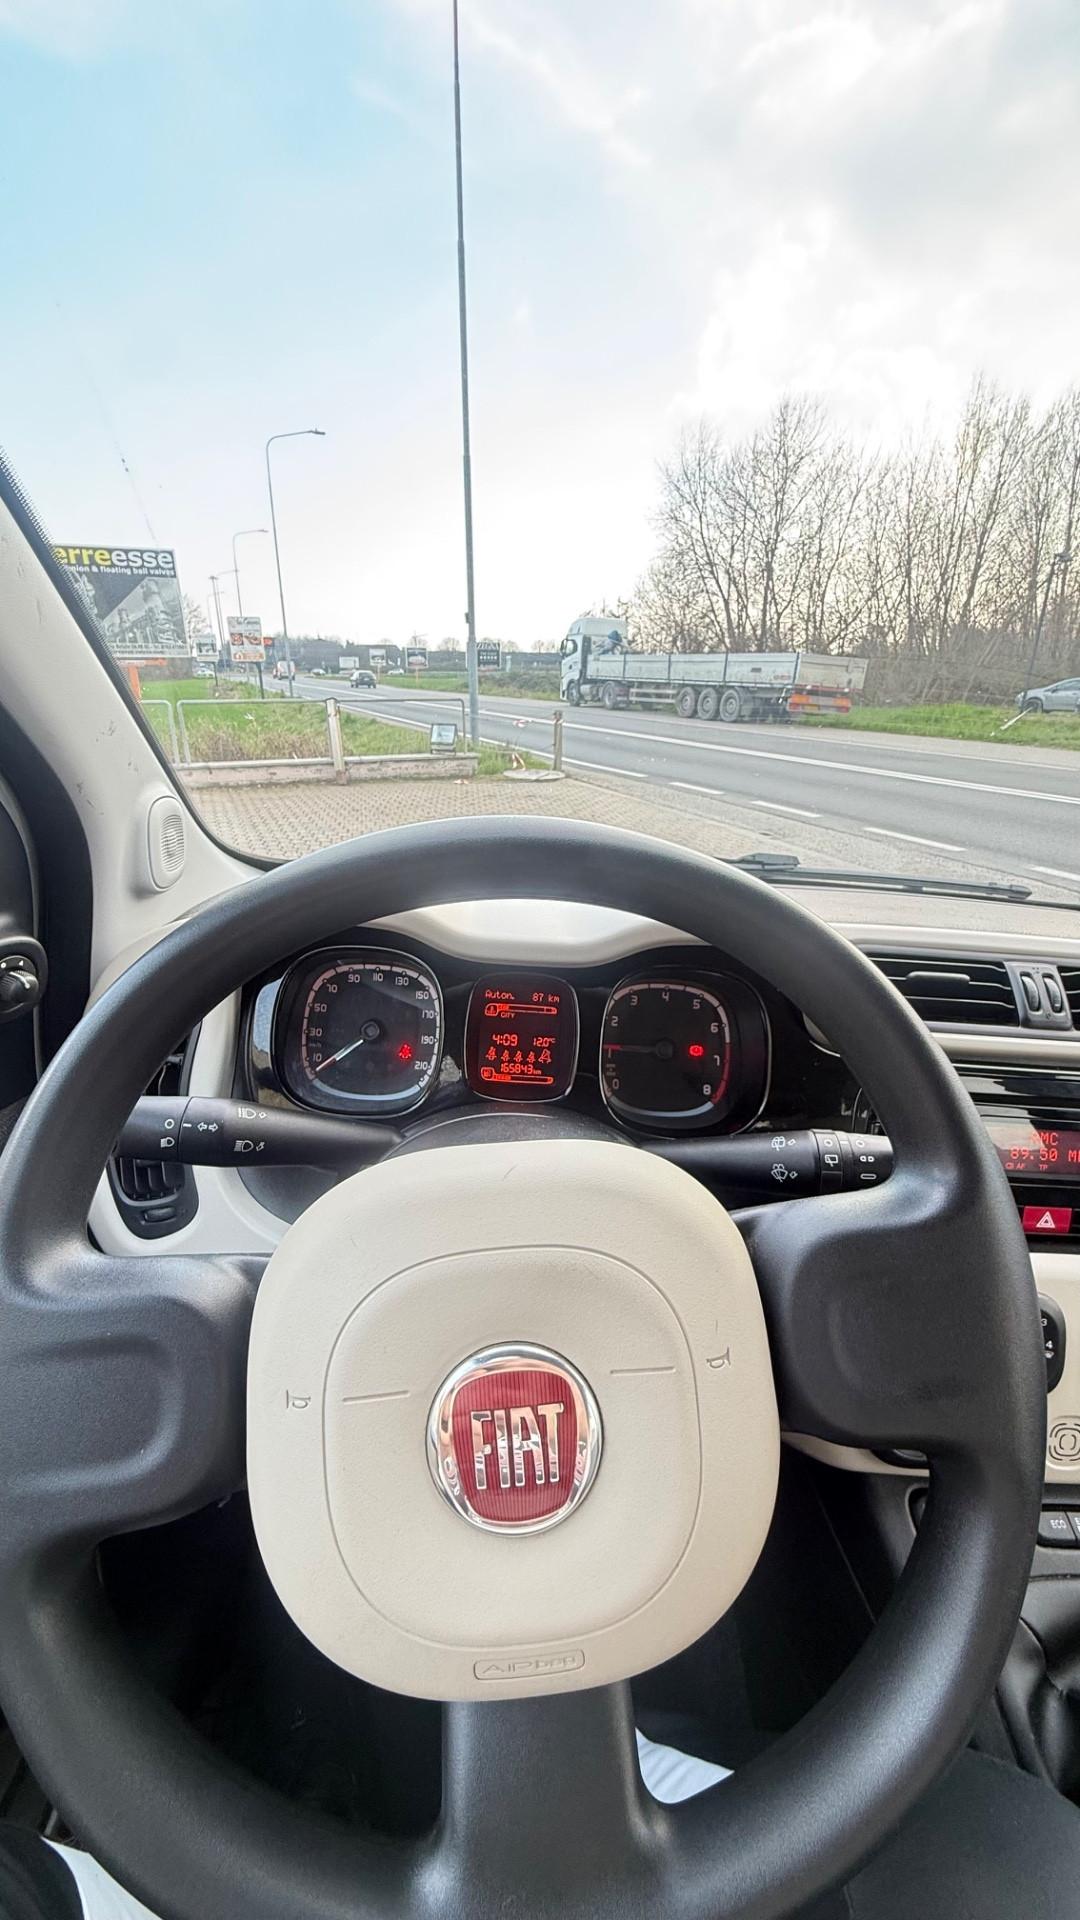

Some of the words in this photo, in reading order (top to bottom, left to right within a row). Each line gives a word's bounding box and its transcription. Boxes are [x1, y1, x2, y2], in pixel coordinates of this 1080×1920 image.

[54, 547, 173, 569] erreesse
[101, 566, 131, 575] floating
[133, 567, 148, 575] ball
[347, 974, 360, 983] 90
[373, 973, 384, 982] 110
[395, 977, 409, 986] 130
[326, 984, 338, 993] 70
[415, 991, 429, 1000] 150
[532, 992, 544, 1002] 87
[548, 994, 560, 1003] km
[630, 994, 638, 1006] 3
[662, 991, 670, 1001] 4
[314, 1004, 327, 1012] 50
[693, 999, 700, 1010] 5
[422, 1011, 434, 1019] 170
[611, 1016, 619, 1027] 2
[710, 1022, 719, 1033] 6
[310, 1029, 322, 1037] 30
[421, 1036, 433, 1045] 190
[492, 1033, 518, 1047] 4:09
[714, 1055, 720, 1066] 7
[414, 1062, 428, 1070] 210
[501, 1063, 533, 1075] 165843
[612, 1079, 620, 1089] 0
[703, 1084, 712, 1095] 8
[1010, 1147, 1058, 1162] 89.50
[1067, 1149, 1080, 1162] M
[470, 1403, 565, 1490] FIAT
[1050, 1519, 1067, 1529] ECO
